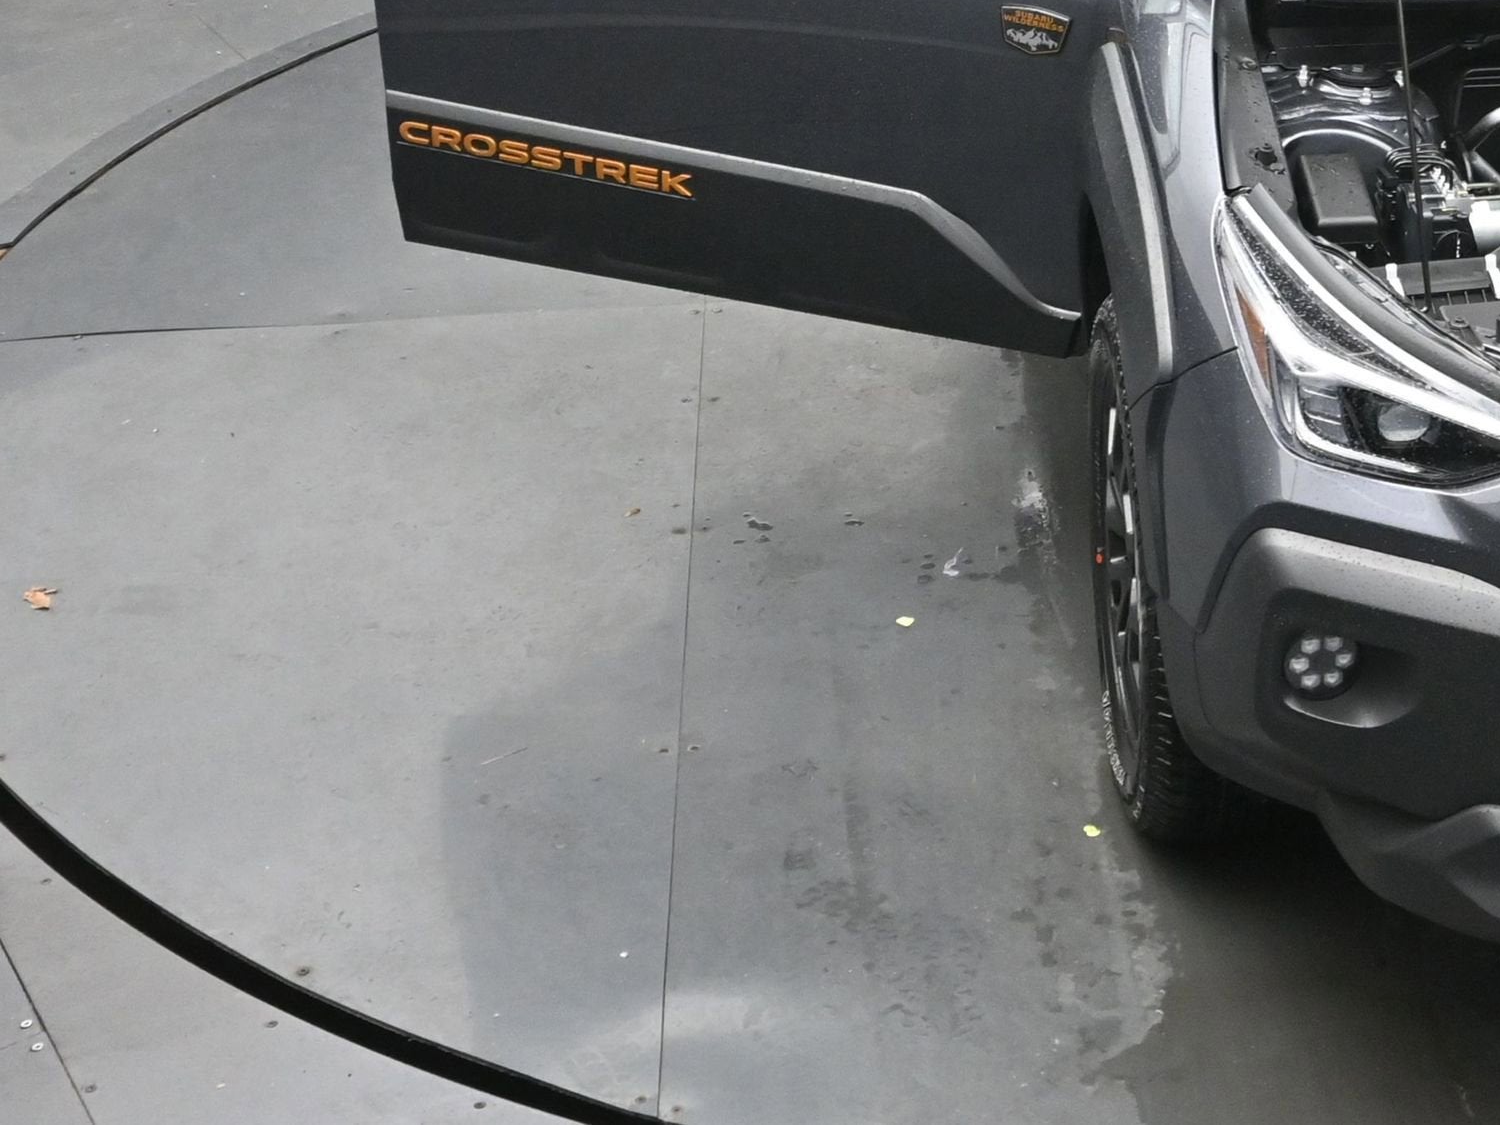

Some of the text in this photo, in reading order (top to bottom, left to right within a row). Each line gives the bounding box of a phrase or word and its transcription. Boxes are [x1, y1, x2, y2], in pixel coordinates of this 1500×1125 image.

[1003, 14, 1066, 33] WILDERNESS
[1014, 10, 1054, 24] SUBARU
[399, 121, 693, 197] CROSSTREK
